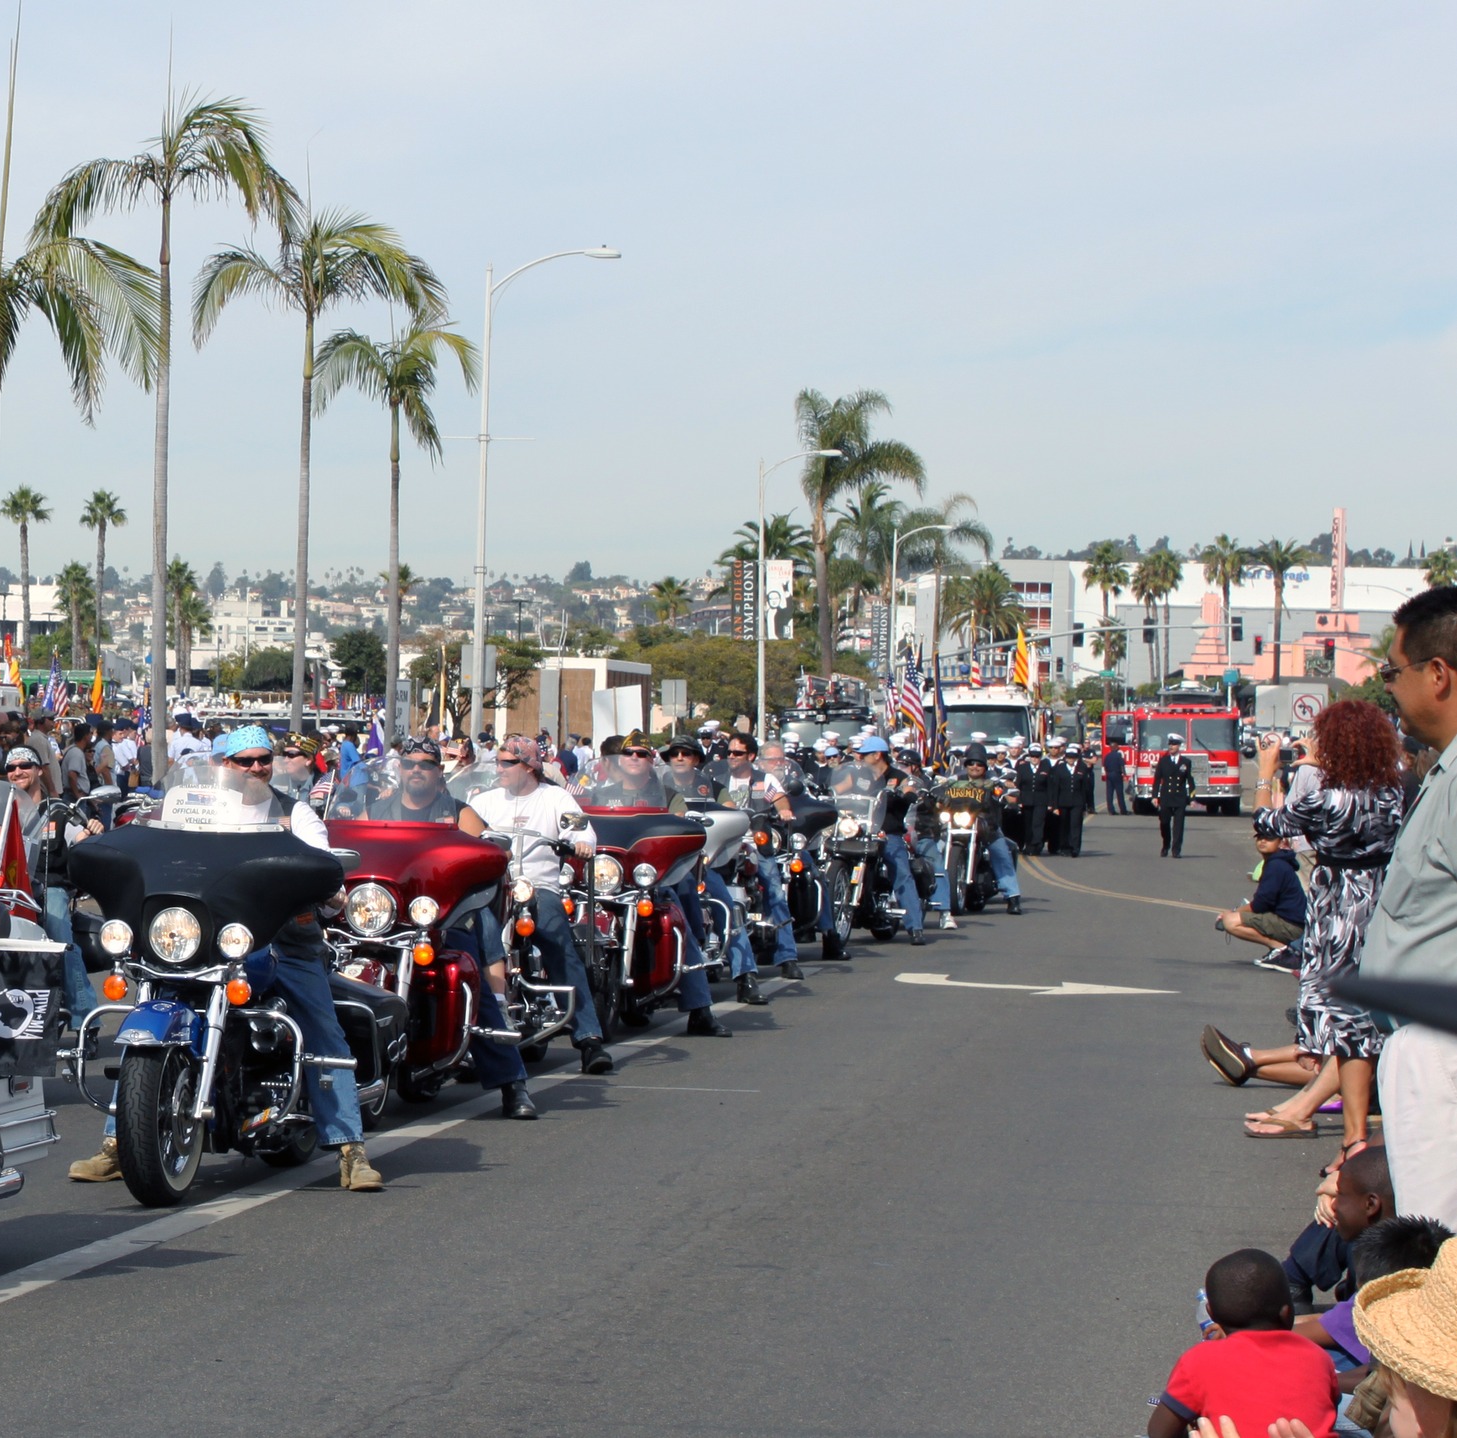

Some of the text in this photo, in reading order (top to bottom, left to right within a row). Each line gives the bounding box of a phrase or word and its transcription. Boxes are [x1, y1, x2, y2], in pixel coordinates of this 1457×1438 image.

[734, 560, 742, 641] SAN DIEGO
[744, 561, 753, 640] SYMPHONY
[1265, 570, 1309, 582] Srage
[1330, 565, 1338, 598] CAMP
[879, 605, 888, 662] SYMPHONY
